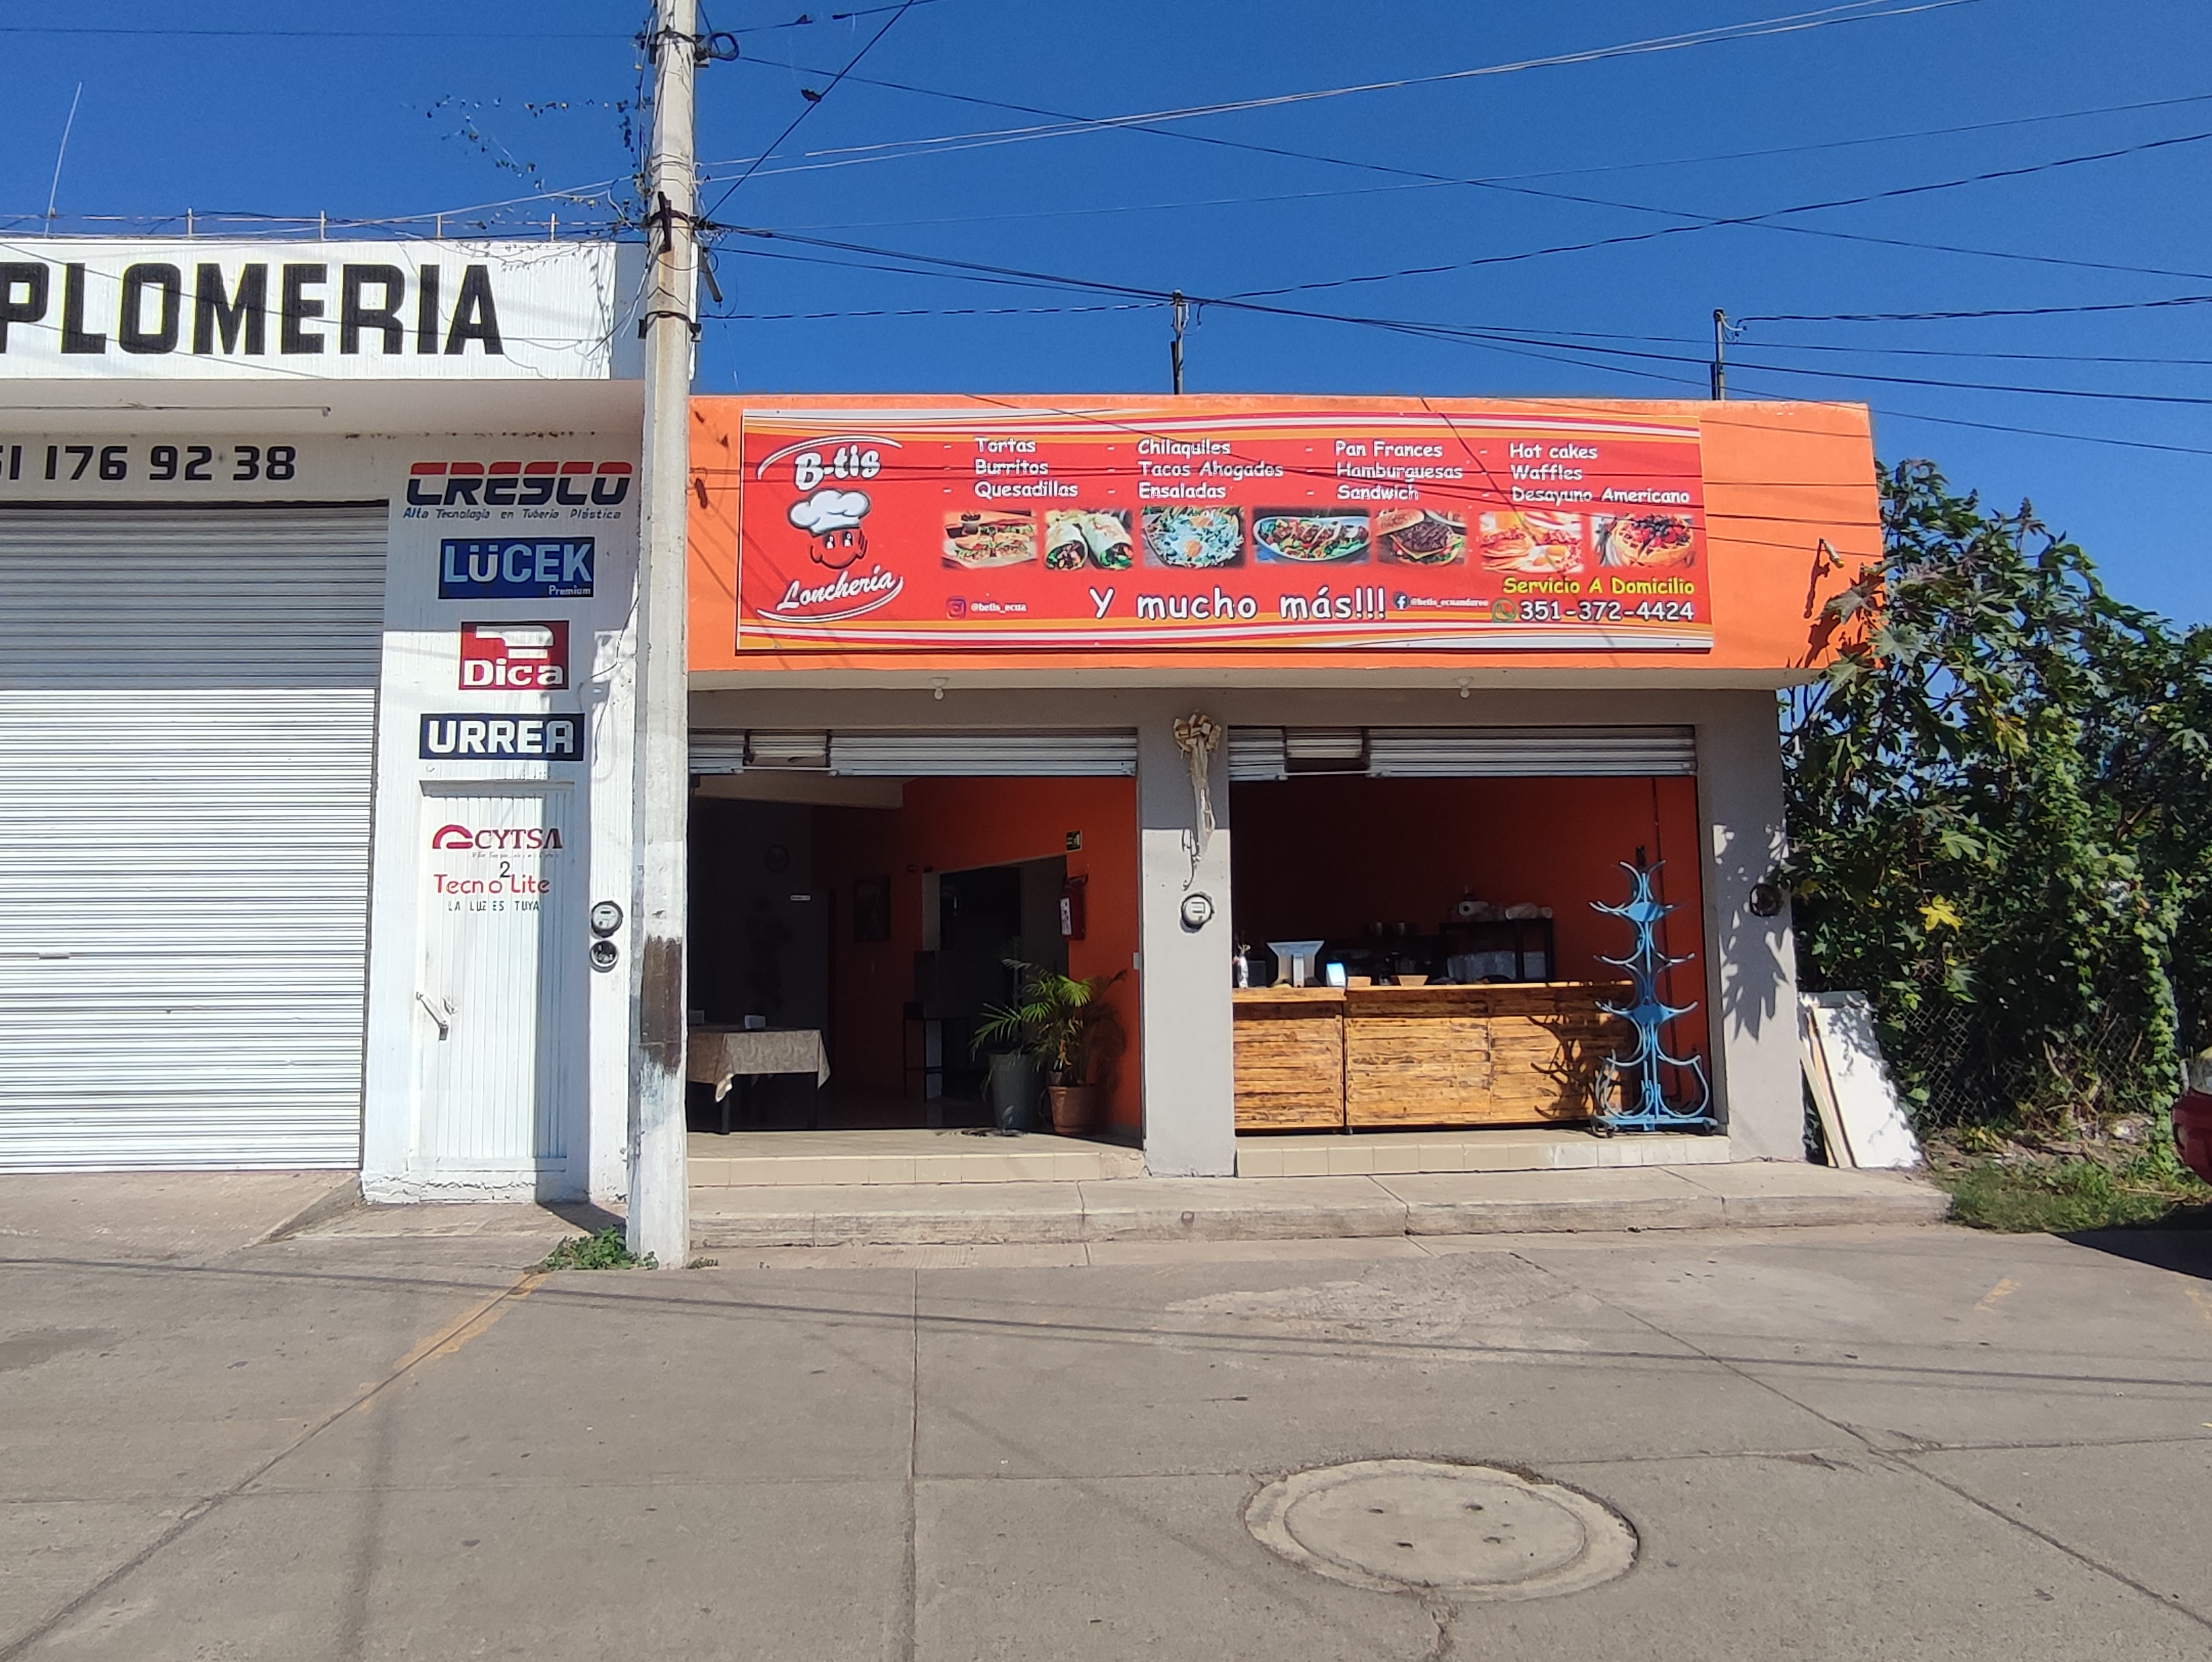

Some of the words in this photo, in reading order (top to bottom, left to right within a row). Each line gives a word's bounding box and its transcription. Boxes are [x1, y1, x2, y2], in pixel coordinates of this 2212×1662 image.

[0, 263, 504, 355] PLOMERIA
[974, 437, 1036, 453] Tortas
[1138, 438, 1231, 459] Chilaquiles
[1335, 440, 1366, 456] Pan
[1374, 440, 1443, 457] Frances
[1510, 442, 1542, 459] Hot
[1549, 443, 1598, 459] cakes
[0, 445, 22, 480] 1
[45, 445, 127, 480] 176
[149, 445, 213, 481] 92
[233, 445, 296, 481] 38
[794, 445, 881, 490] B-tis
[974, 459, 1049, 475] Burritos
[1138, 461, 1191, 476] Tacos
[1199, 460, 1284, 481] Ahogados
[1337, 461, 1463, 483] Hamburguesas
[1511, 464, 1583, 480] Waffles
[407, 462, 633, 505] CRESCO
[974, 480, 1078, 500] Quesadillas
[1138, 482, 1226, 498] Ensaladas
[1337, 484, 1420, 500] Sandwich
[1511, 486, 1593, 506] Desayuno
[1601, 487, 1690, 503] Americano
[570, 507, 622, 519] Plástica
[548, 585, 591, 595] Premium
[1503, 577, 1581, 594] Servicio
[1589, 577, 1603, 594] A
[1611, 577, 1695, 595] Domicilio
[1088, 588, 1115, 619] Y
[1137, 587, 1258, 619] mucho
[1279, 585, 1386, 620] más!!!
[1520, 600, 1695, 621] 351-372-4424
[463, 658, 564, 686] Dica
[428, 720, 575, 754] URREA
[475, 828, 563, 849] CYTSA
[499, 861, 511, 878] 2
